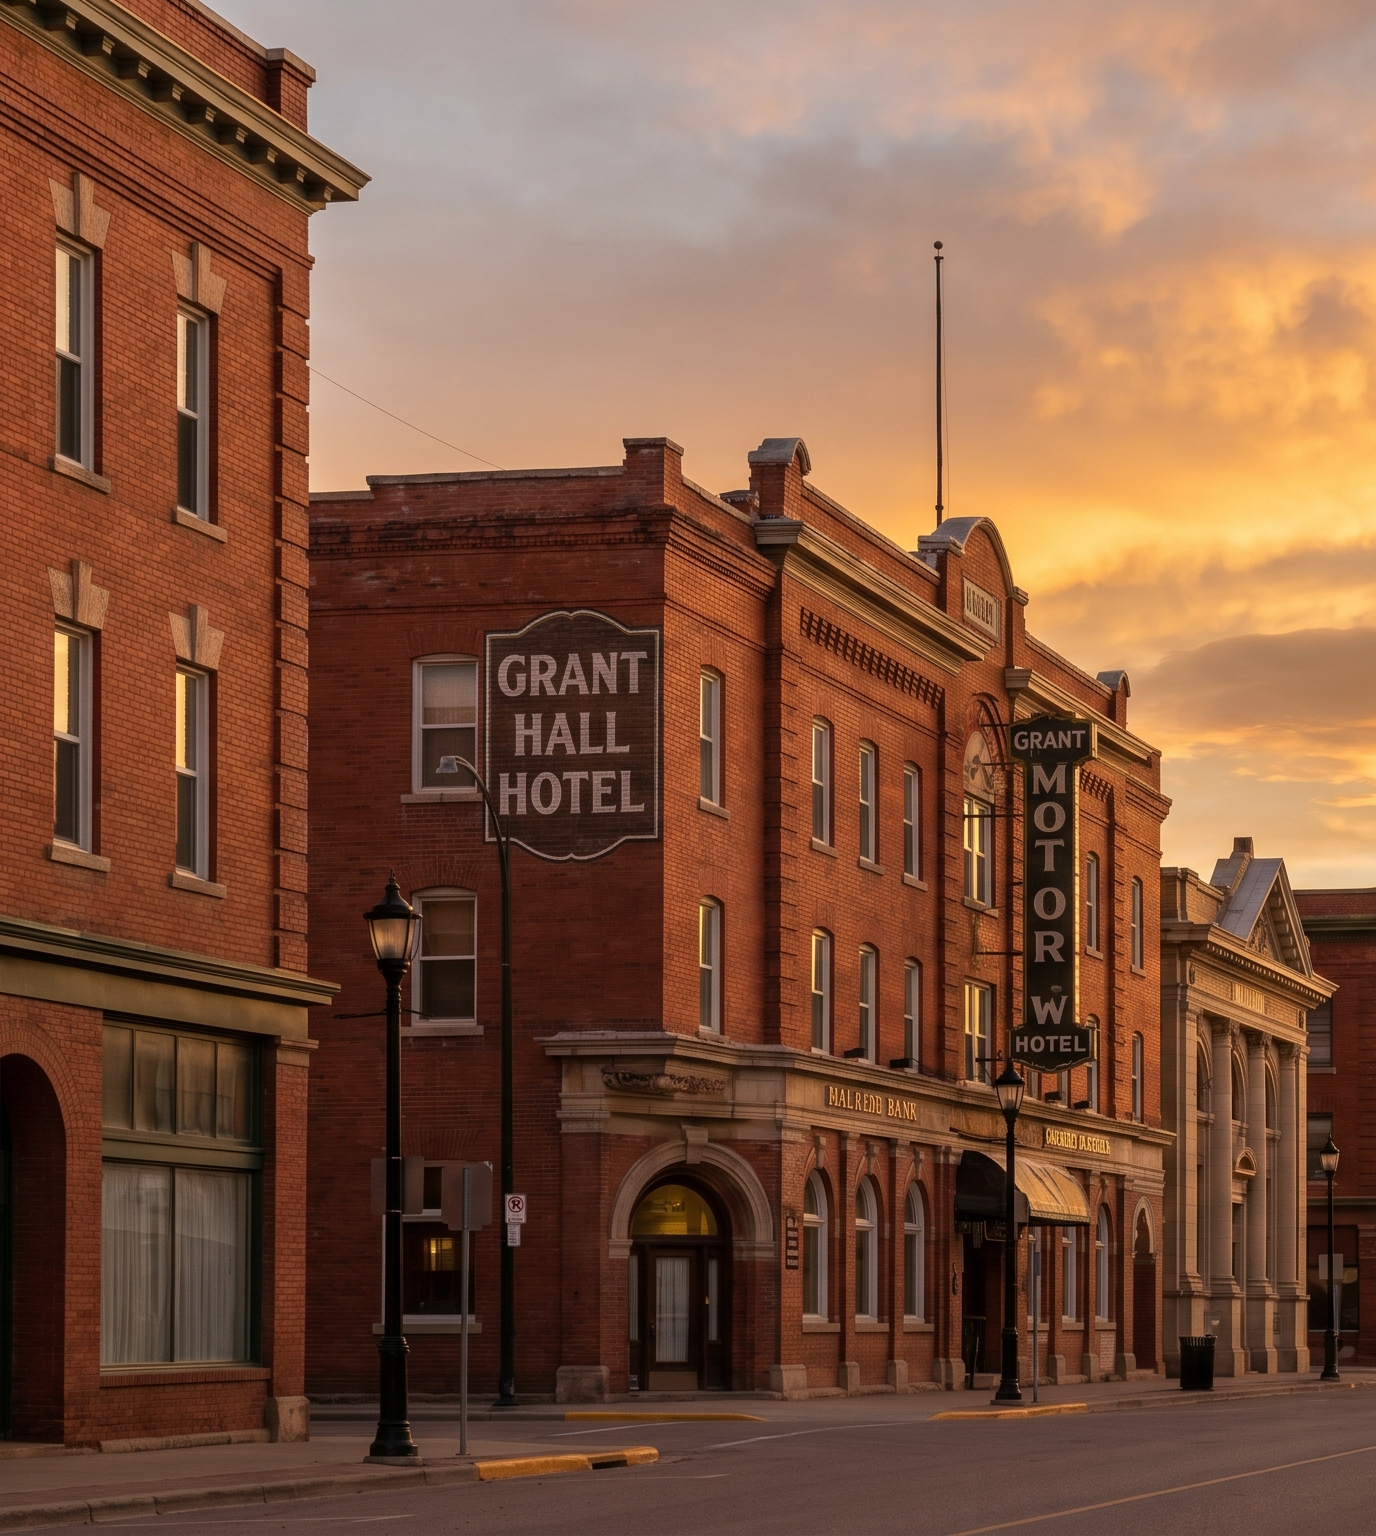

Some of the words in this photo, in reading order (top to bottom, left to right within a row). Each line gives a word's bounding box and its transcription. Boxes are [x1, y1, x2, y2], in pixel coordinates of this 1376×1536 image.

[497, 651, 648, 697] GRANT
[514, 711, 630, 756] HALL
[1013, 730, 1086, 750] GRANT
[498, 770, 645, 816] HOTEL
[1015, 1035, 1086, 1053] HOTEL
[887, 1098, 917, 1121] BANK
